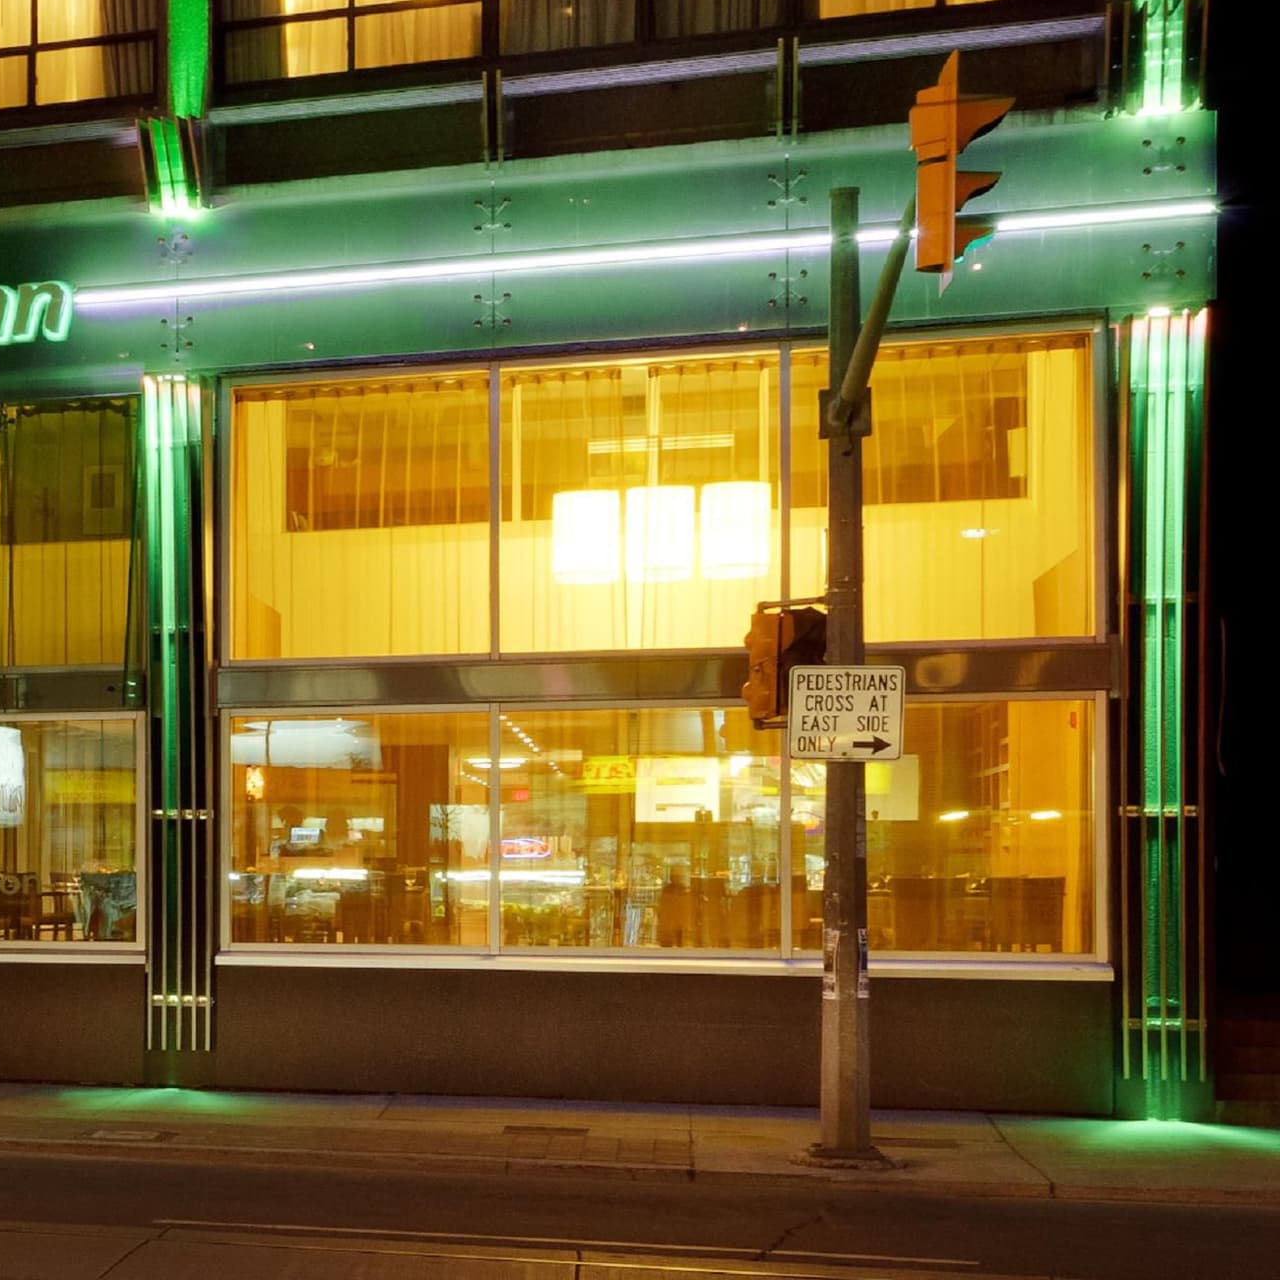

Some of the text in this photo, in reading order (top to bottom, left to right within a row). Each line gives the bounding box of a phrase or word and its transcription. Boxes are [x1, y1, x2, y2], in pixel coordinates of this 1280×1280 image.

[796, 673, 898, 692] PEDESTRIANS
[805, 694, 888, 712] CROSS AT
[801, 715, 889, 733] EAST SIDE
[797, 736, 837, 753] ONLY
